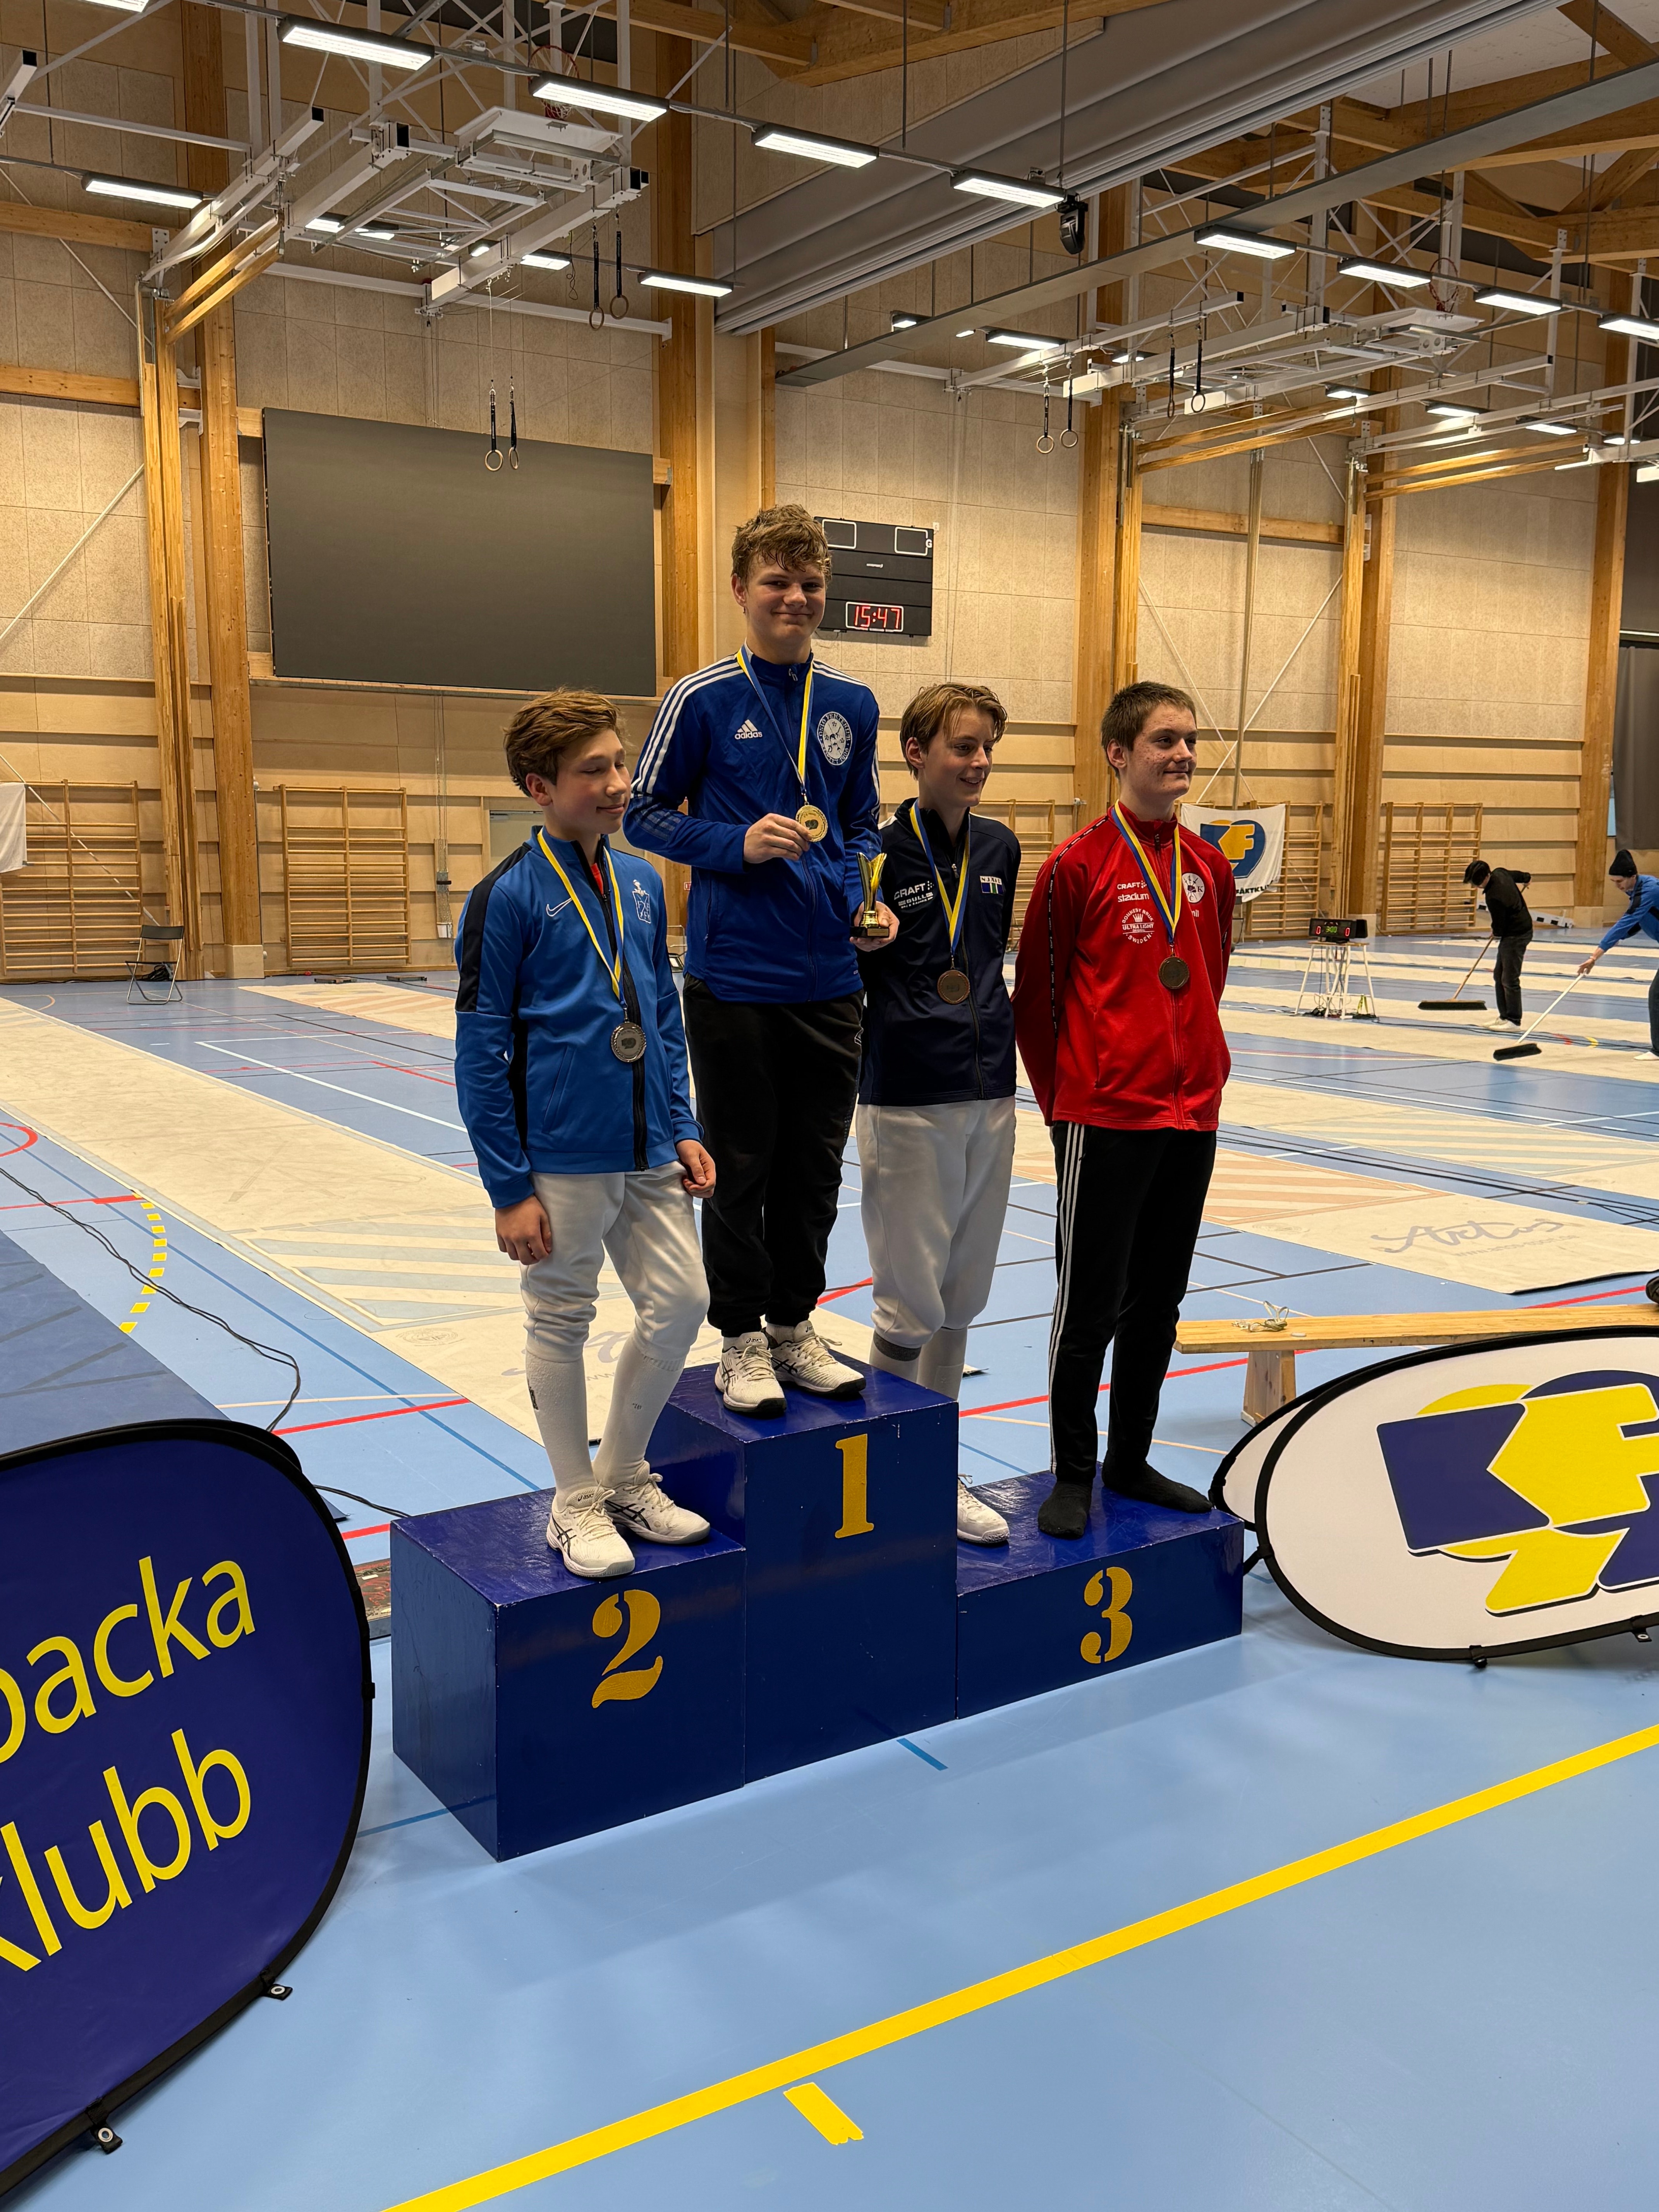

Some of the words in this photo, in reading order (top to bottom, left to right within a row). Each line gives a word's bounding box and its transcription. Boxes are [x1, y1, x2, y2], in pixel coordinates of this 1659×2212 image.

[854, 606, 900, 629] 15:47
[735, 732, 763, 740] adidas
[894, 883, 926, 900] CRAFT
[1118, 893, 1149, 902] stadium
[1128, 933, 1152, 944] SWEDEN
[835, 1433, 874, 1539] 1
[1080, 1566, 1133, 1664] 3
[591, 1589, 663, 1709] 2
[0, 1728, 252, 1972] lubb
